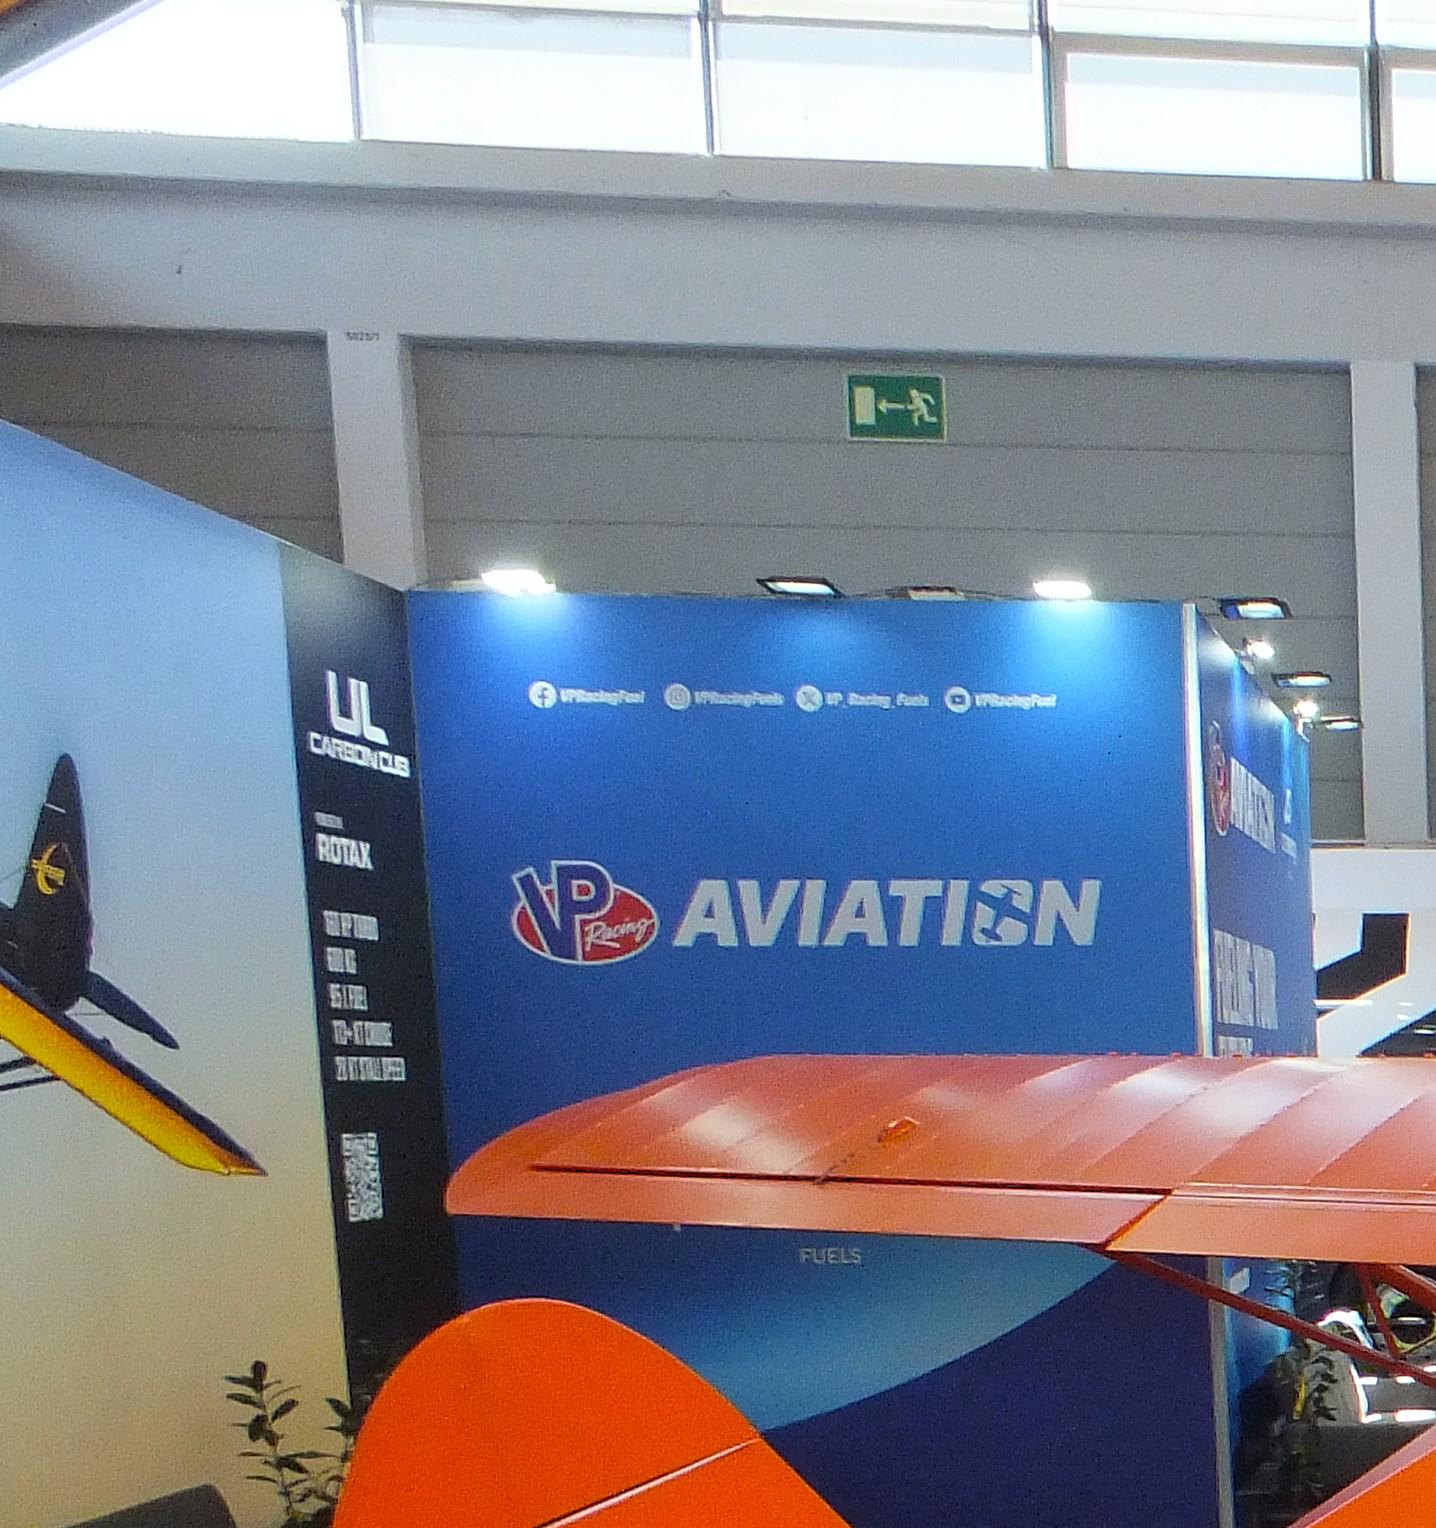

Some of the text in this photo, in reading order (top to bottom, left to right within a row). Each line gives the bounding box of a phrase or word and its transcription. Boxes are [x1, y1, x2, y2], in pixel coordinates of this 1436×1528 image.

[326, 670, 389, 746] UL
[316, 833, 374, 871] ROTAX
[512, 860, 614, 962] VP
[584, 917, 656, 951] Racing
[672, 879, 1100, 947] AVIATION
[800, 1247, 861, 1264] FUELS
